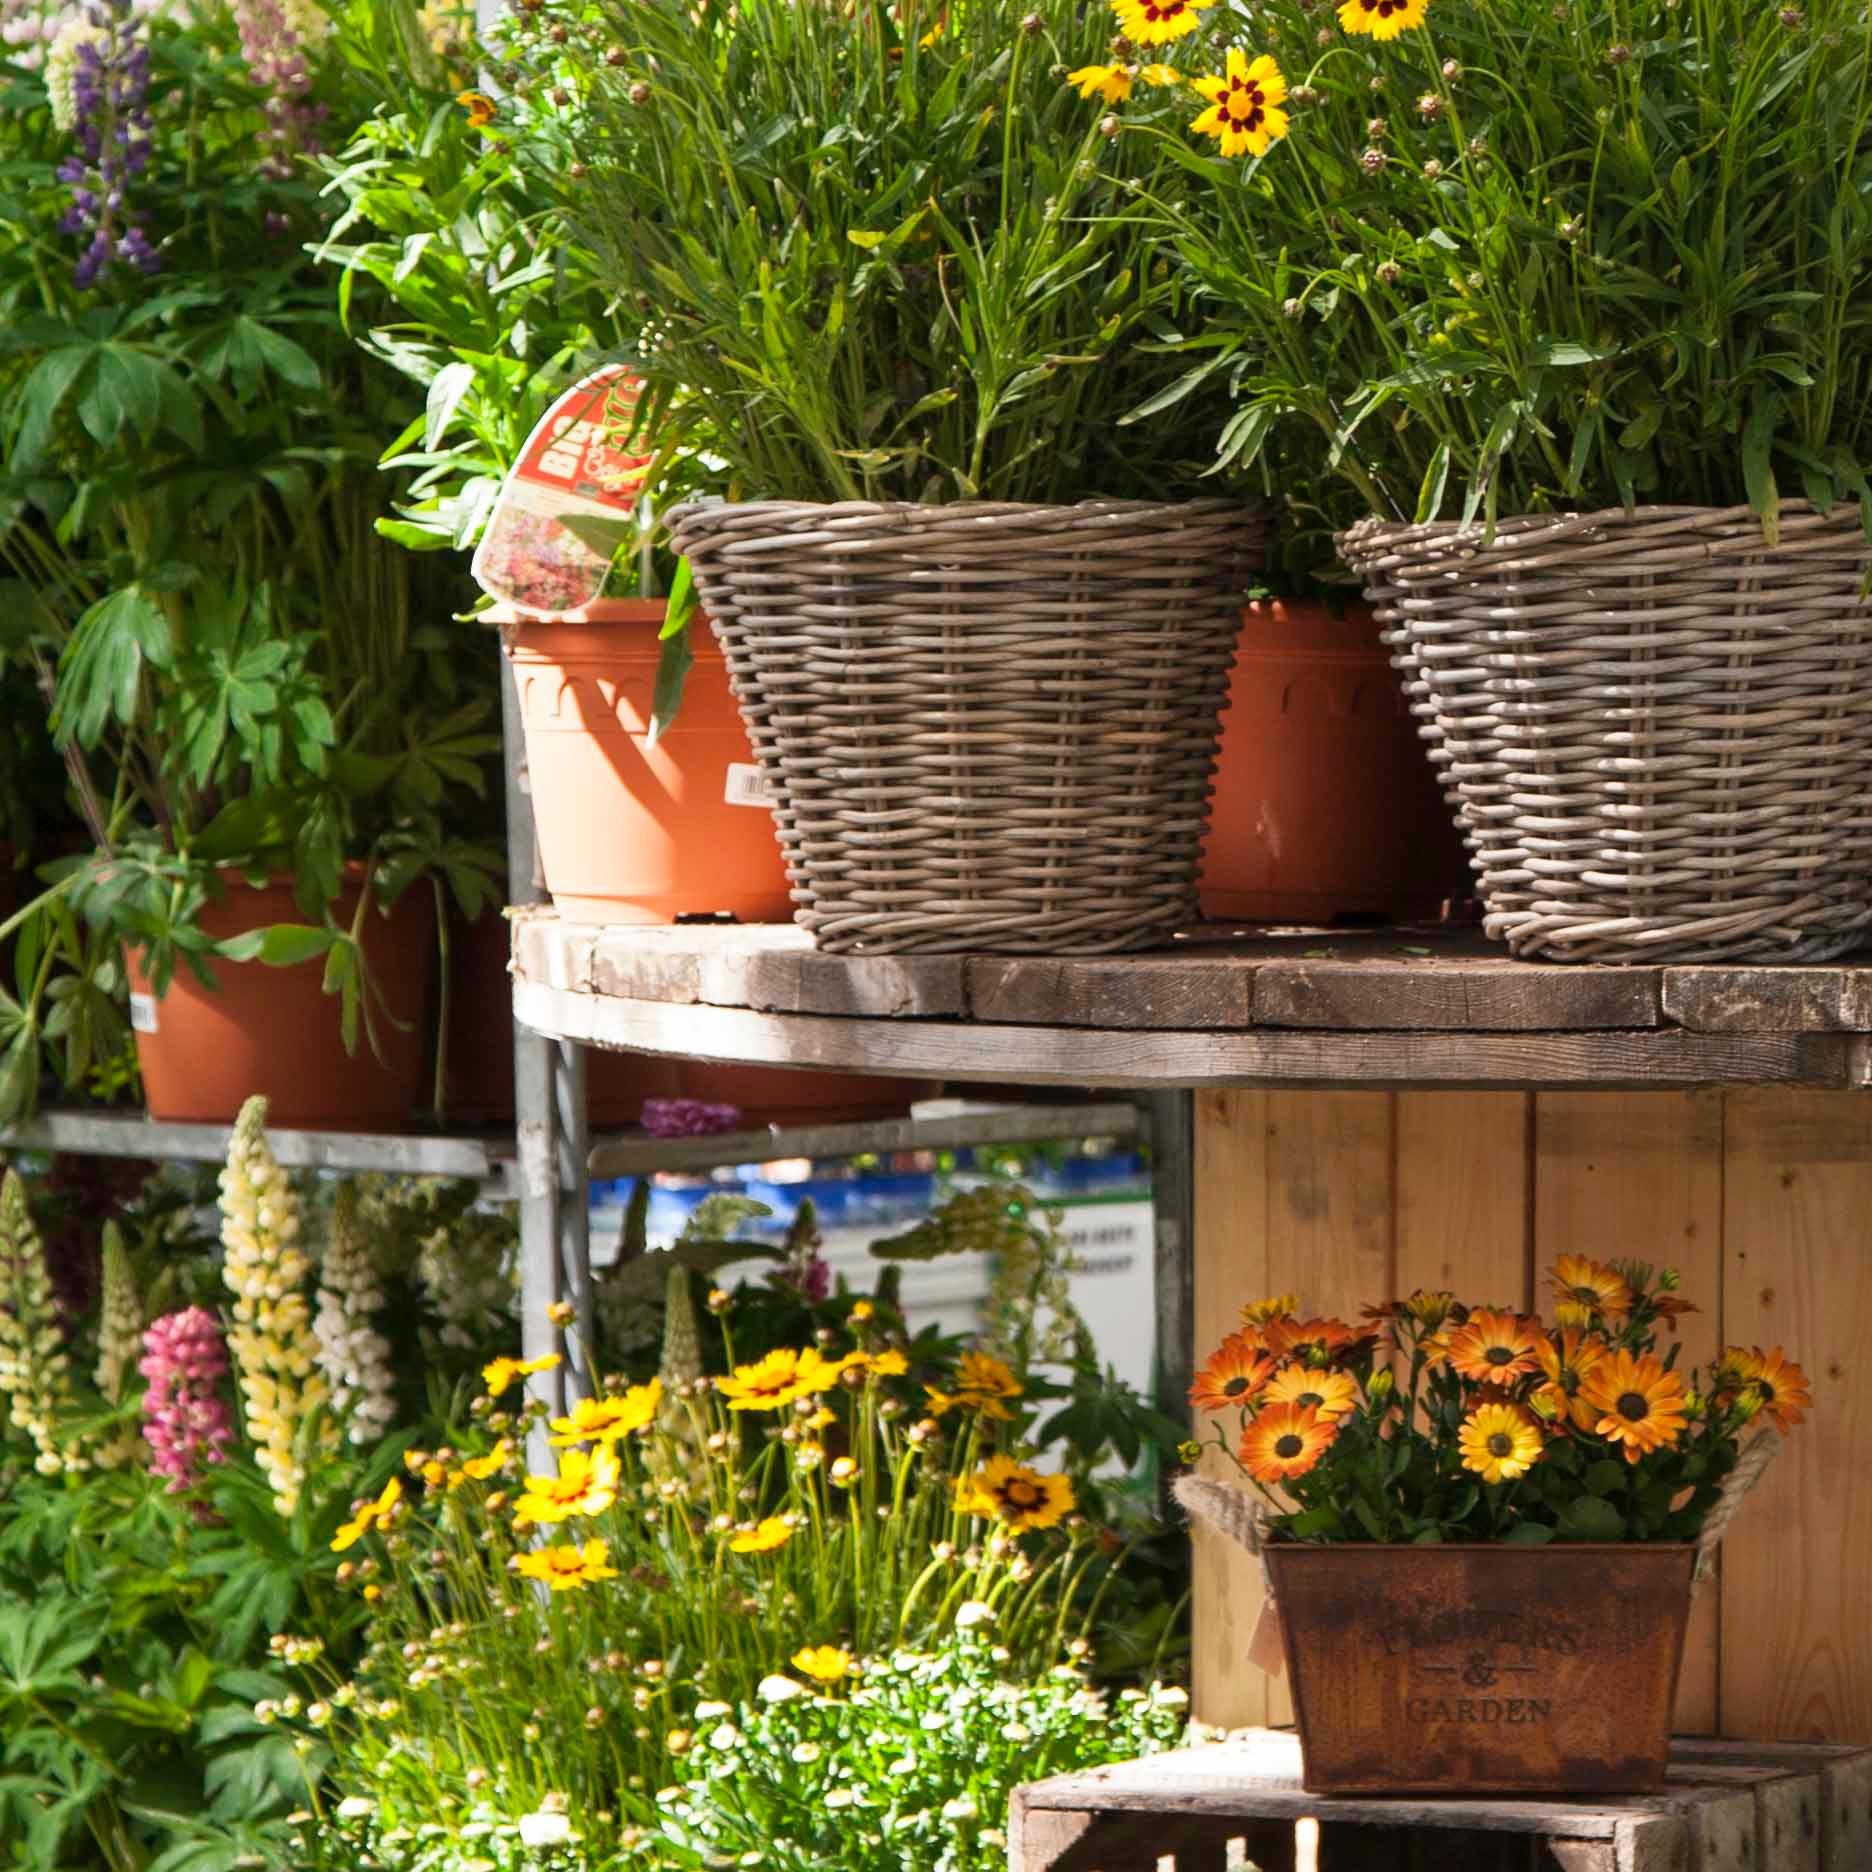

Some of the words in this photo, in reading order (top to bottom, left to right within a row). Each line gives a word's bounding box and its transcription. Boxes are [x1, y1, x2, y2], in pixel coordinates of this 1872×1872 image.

[538, 415, 593, 479] BIG
[1462, 1651, 1499, 1688] &
[1405, 1698, 1553, 1724] GARDEN
